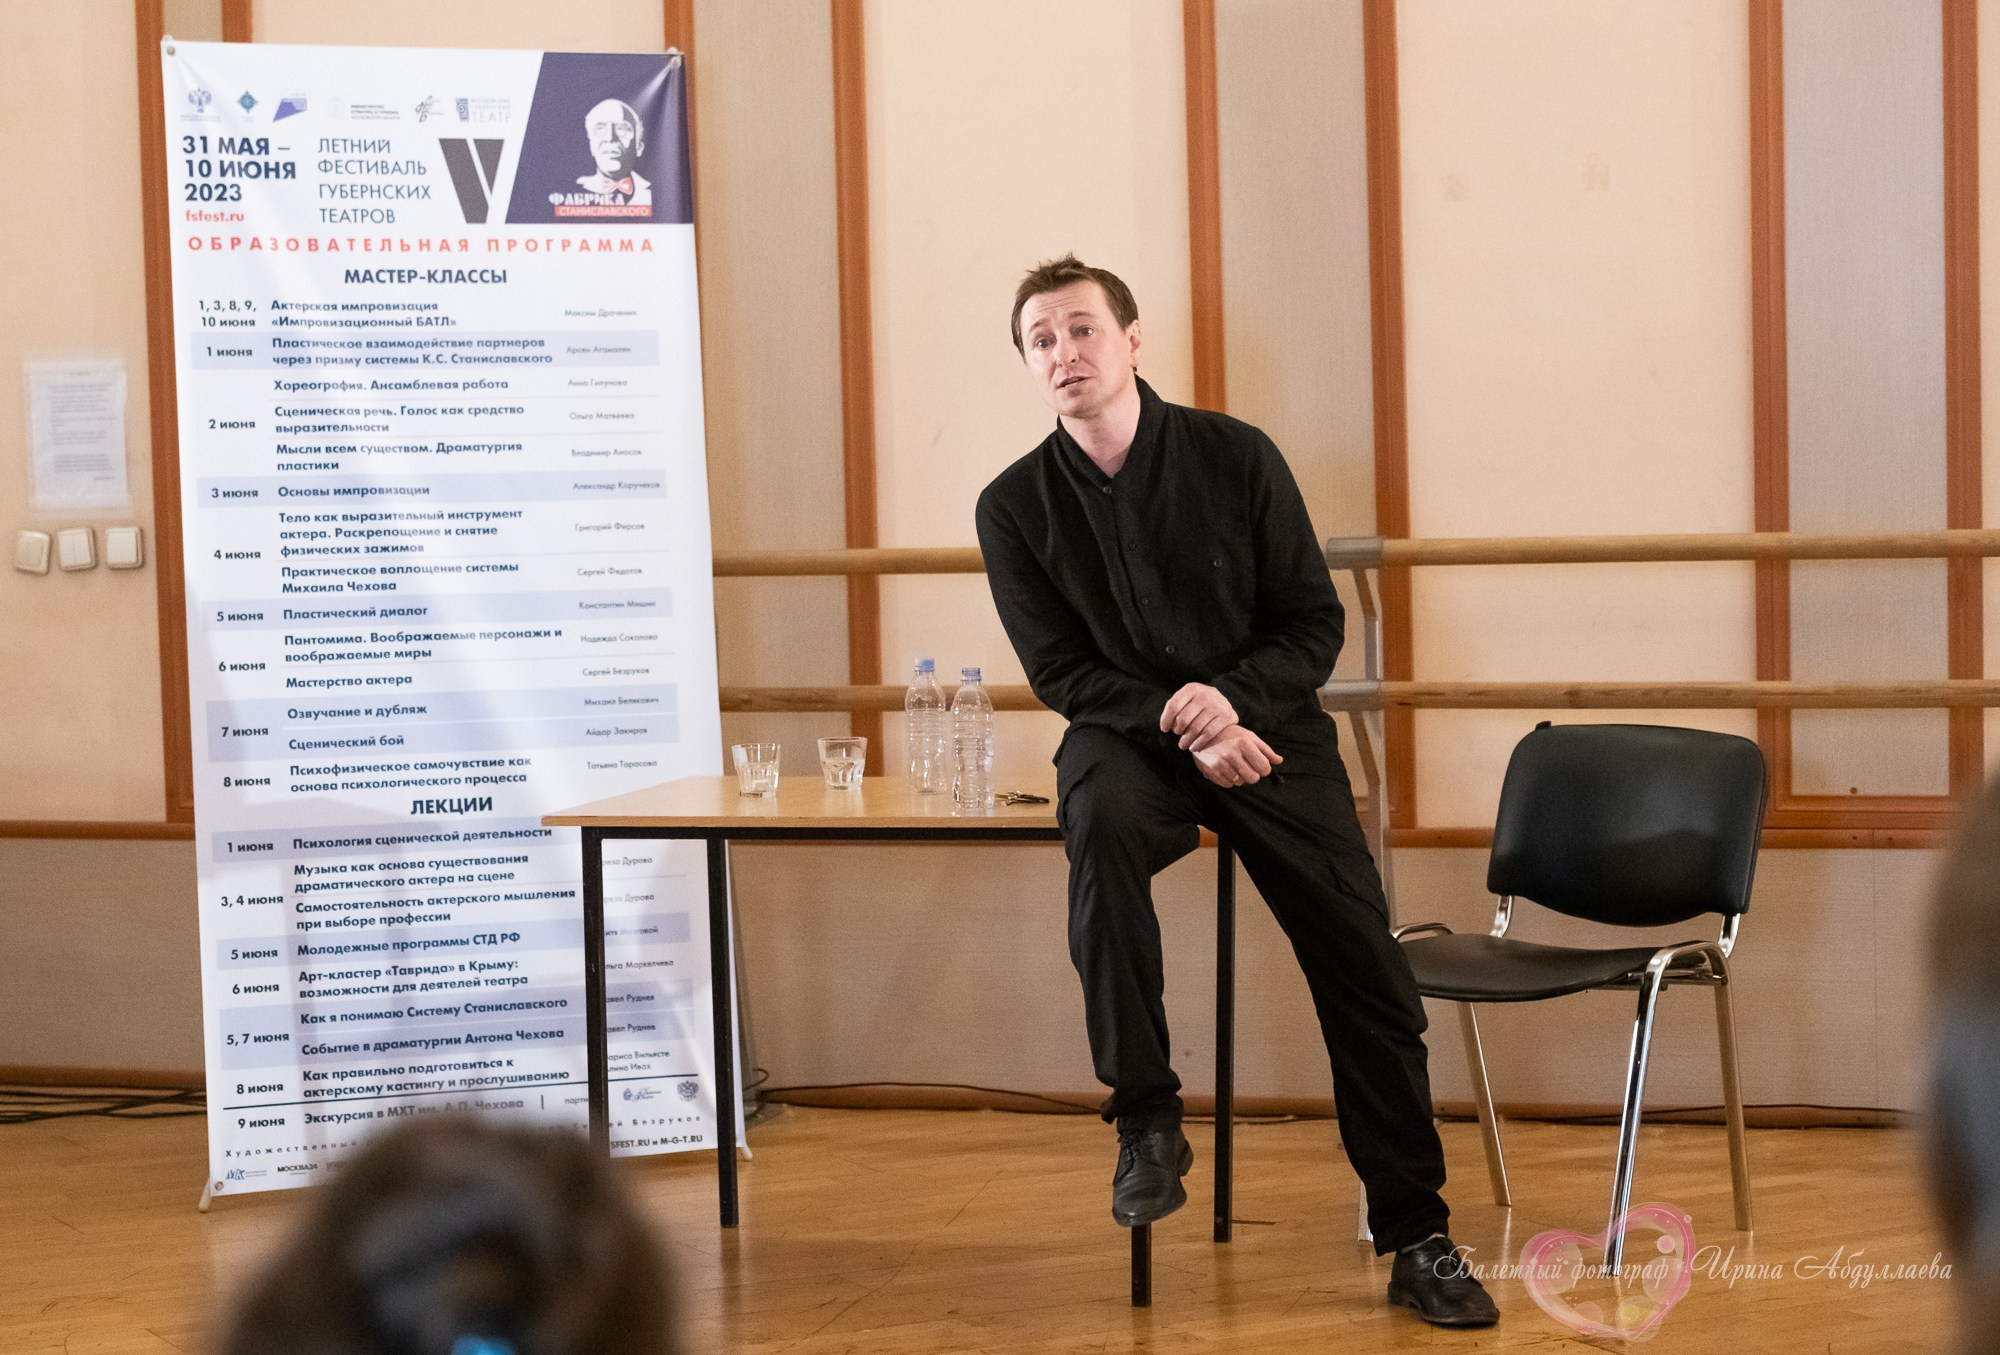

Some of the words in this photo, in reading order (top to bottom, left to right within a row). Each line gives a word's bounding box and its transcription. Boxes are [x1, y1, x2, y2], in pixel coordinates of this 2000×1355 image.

[182, 134, 208, 154] 31
[218, 136, 270, 156] МАЯ
[317, 137, 391, 154] ЛЕТНИЙ
[185, 158, 212, 178] 10
[219, 159, 296, 180] ИЮНЯ
[317, 158, 427, 176] ФЕСТИВАЛЬ
[184, 182, 242, 202] 2023
[318, 183, 431, 200] ГУБЕРНСКИХ
[548, 192, 626, 206] ФАБРИКА
[185, 209, 244, 222] fsfest.ru
[319, 207, 396, 224] ТЕАТРОВ
[559, 205, 650, 217] СТАНИСЛАВСКОГО
[187, 235, 469, 252] ОБРАЗОВАТЕЛЬНАЯ
[487, 238, 653, 253] ПРОГРАММА
[344, 268, 507, 284] МАСТЕР-КЛАССЫ
[198, 299, 210, 312] 1,
[213, 299, 225, 312] 3,
[228, 299, 241, 312] 8,
[243, 299, 256, 312] 9,
[270, 299, 338, 312] Актерская
[341, 303, 438, 313] импровизация
[271, 337, 362, 349] Пластическое
[365, 339, 473, 349] взаимодействие
[476, 339, 545, 350] партнеров
[273, 380, 368, 393] Хореография.
[370, 379, 459, 390] Ансамблевая
[461, 378, 509, 392] работа
[274, 405, 361, 418] Сценическая
[363, 408, 397, 418] речь.
[400, 405, 437, 416] Голос
[440, 407, 464, 415] как
[467, 406, 525, 417] средство
[208, 418, 216, 429] 2
[219, 420, 256, 429] июня
[275, 424, 389, 436] выразительности
[275, 443, 321, 454] Мысли
[324, 445, 357, 454] всем
[360, 445, 432, 454] существом.
[435, 442, 522, 455] Драматургия
[276, 462, 339, 471] пластики
[277, 485, 330, 497] Основы
[333, 487, 430, 498] импровизации
[278, 512, 311, 523] Тело
[313, 514, 338, 522] как
[341, 512, 444, 524] выразительный
[447, 510, 522, 522] инструмент
[280, 545, 360, 558] физических
[364, 544, 424, 554] зажимов
[281, 582, 344, 593] Михаила
[346, 581, 397, 591] Чехова
[282, 606, 377, 620] Пластический
[379, 607, 428, 618] диалог
[284, 634, 366, 646] Пантомима.
[370, 631, 476, 644] Воображаемые
[478, 629, 551, 641] персонажи
[554, 629, 562, 637] и
[285, 677, 363, 689] Мастерство
[365, 675, 412, 687] актера
[288, 736, 376, 751] Сценический
[378, 734, 404, 746] бой
[289, 762, 410, 777] Психофизическое
[413, 758, 505, 771] самочувствие
[508, 758, 532, 766] как
[290, 782, 338, 793] основа
[341, 776, 462, 790] психологического
[464, 774, 527, 787] процесса
[410, 796, 493, 815] ЛЕКЦИИ
[292, 837, 372, 850] Психология
[374, 830, 460, 846] сценической
[462, 828, 552, 842] деятельности
[294, 877, 405, 894] драматического
[407, 875, 455, 887] актера
[457, 874, 474, 882] на
[476, 871, 515, 883] сцене
[220, 895, 233, 908] 3,
[235, 894, 244, 906] 4
[247, 895, 284, 905] июня
[295, 898, 424, 913] Самостоятельность
[426, 893, 501, 906] актерского
[503, 890, 576, 901] мышления
[296, 920, 322, 932] при
[324, 915, 376, 929] выборе
[378, 912, 451, 927] профессии
[297, 942, 389, 956] Молодежные
[392, 937, 470, 952] программы
[472, 933, 498, 946] СТД
[500, 931, 521, 944] РФ
[298, 969, 382, 984] Арт-кластер
[458, 963, 466, 972] в
[468, 960, 518, 973] Крыму:
[299, 985, 389, 999] возможности
[392, 983, 417, 994] для
[419, 977, 481, 992] деятелей
[483, 976, 528, 988] театра
[300, 1013, 326, 1025] Как
[329, 1014, 337, 1022] я
[339, 1010, 404, 1022] понимаю
[406, 1006, 461, 1018] Систему
[463, 998, 568, 1014] Станиславского
[226, 1033, 239, 1046] 5,
[241, 1032, 250, 1044] 7
[253, 1033, 290, 1043] июня
[301, 1042, 360, 1056] Событие
[362, 1042, 371, 1051] в
[372, 1036, 462, 1053] драматургии
[464, 1033, 513, 1044] Антона
[515, 1029, 564, 1040] Чехова
[303, 1084, 384, 1098] актерскому
[386, 1080, 445, 1092] кастингу
[447, 1079, 456, 1087] и
[459, 1071, 570, 1088] прослушиванию
[237, 1117, 246, 1129] 9
[248, 1117, 285, 1128] июня
[304, 1111, 374, 1126] Экскурсия
[376, 1110, 384, 1119] в
[387, 1105, 416, 1117] МХТ
[610, 1139, 651, 1150] SFEST.RU
